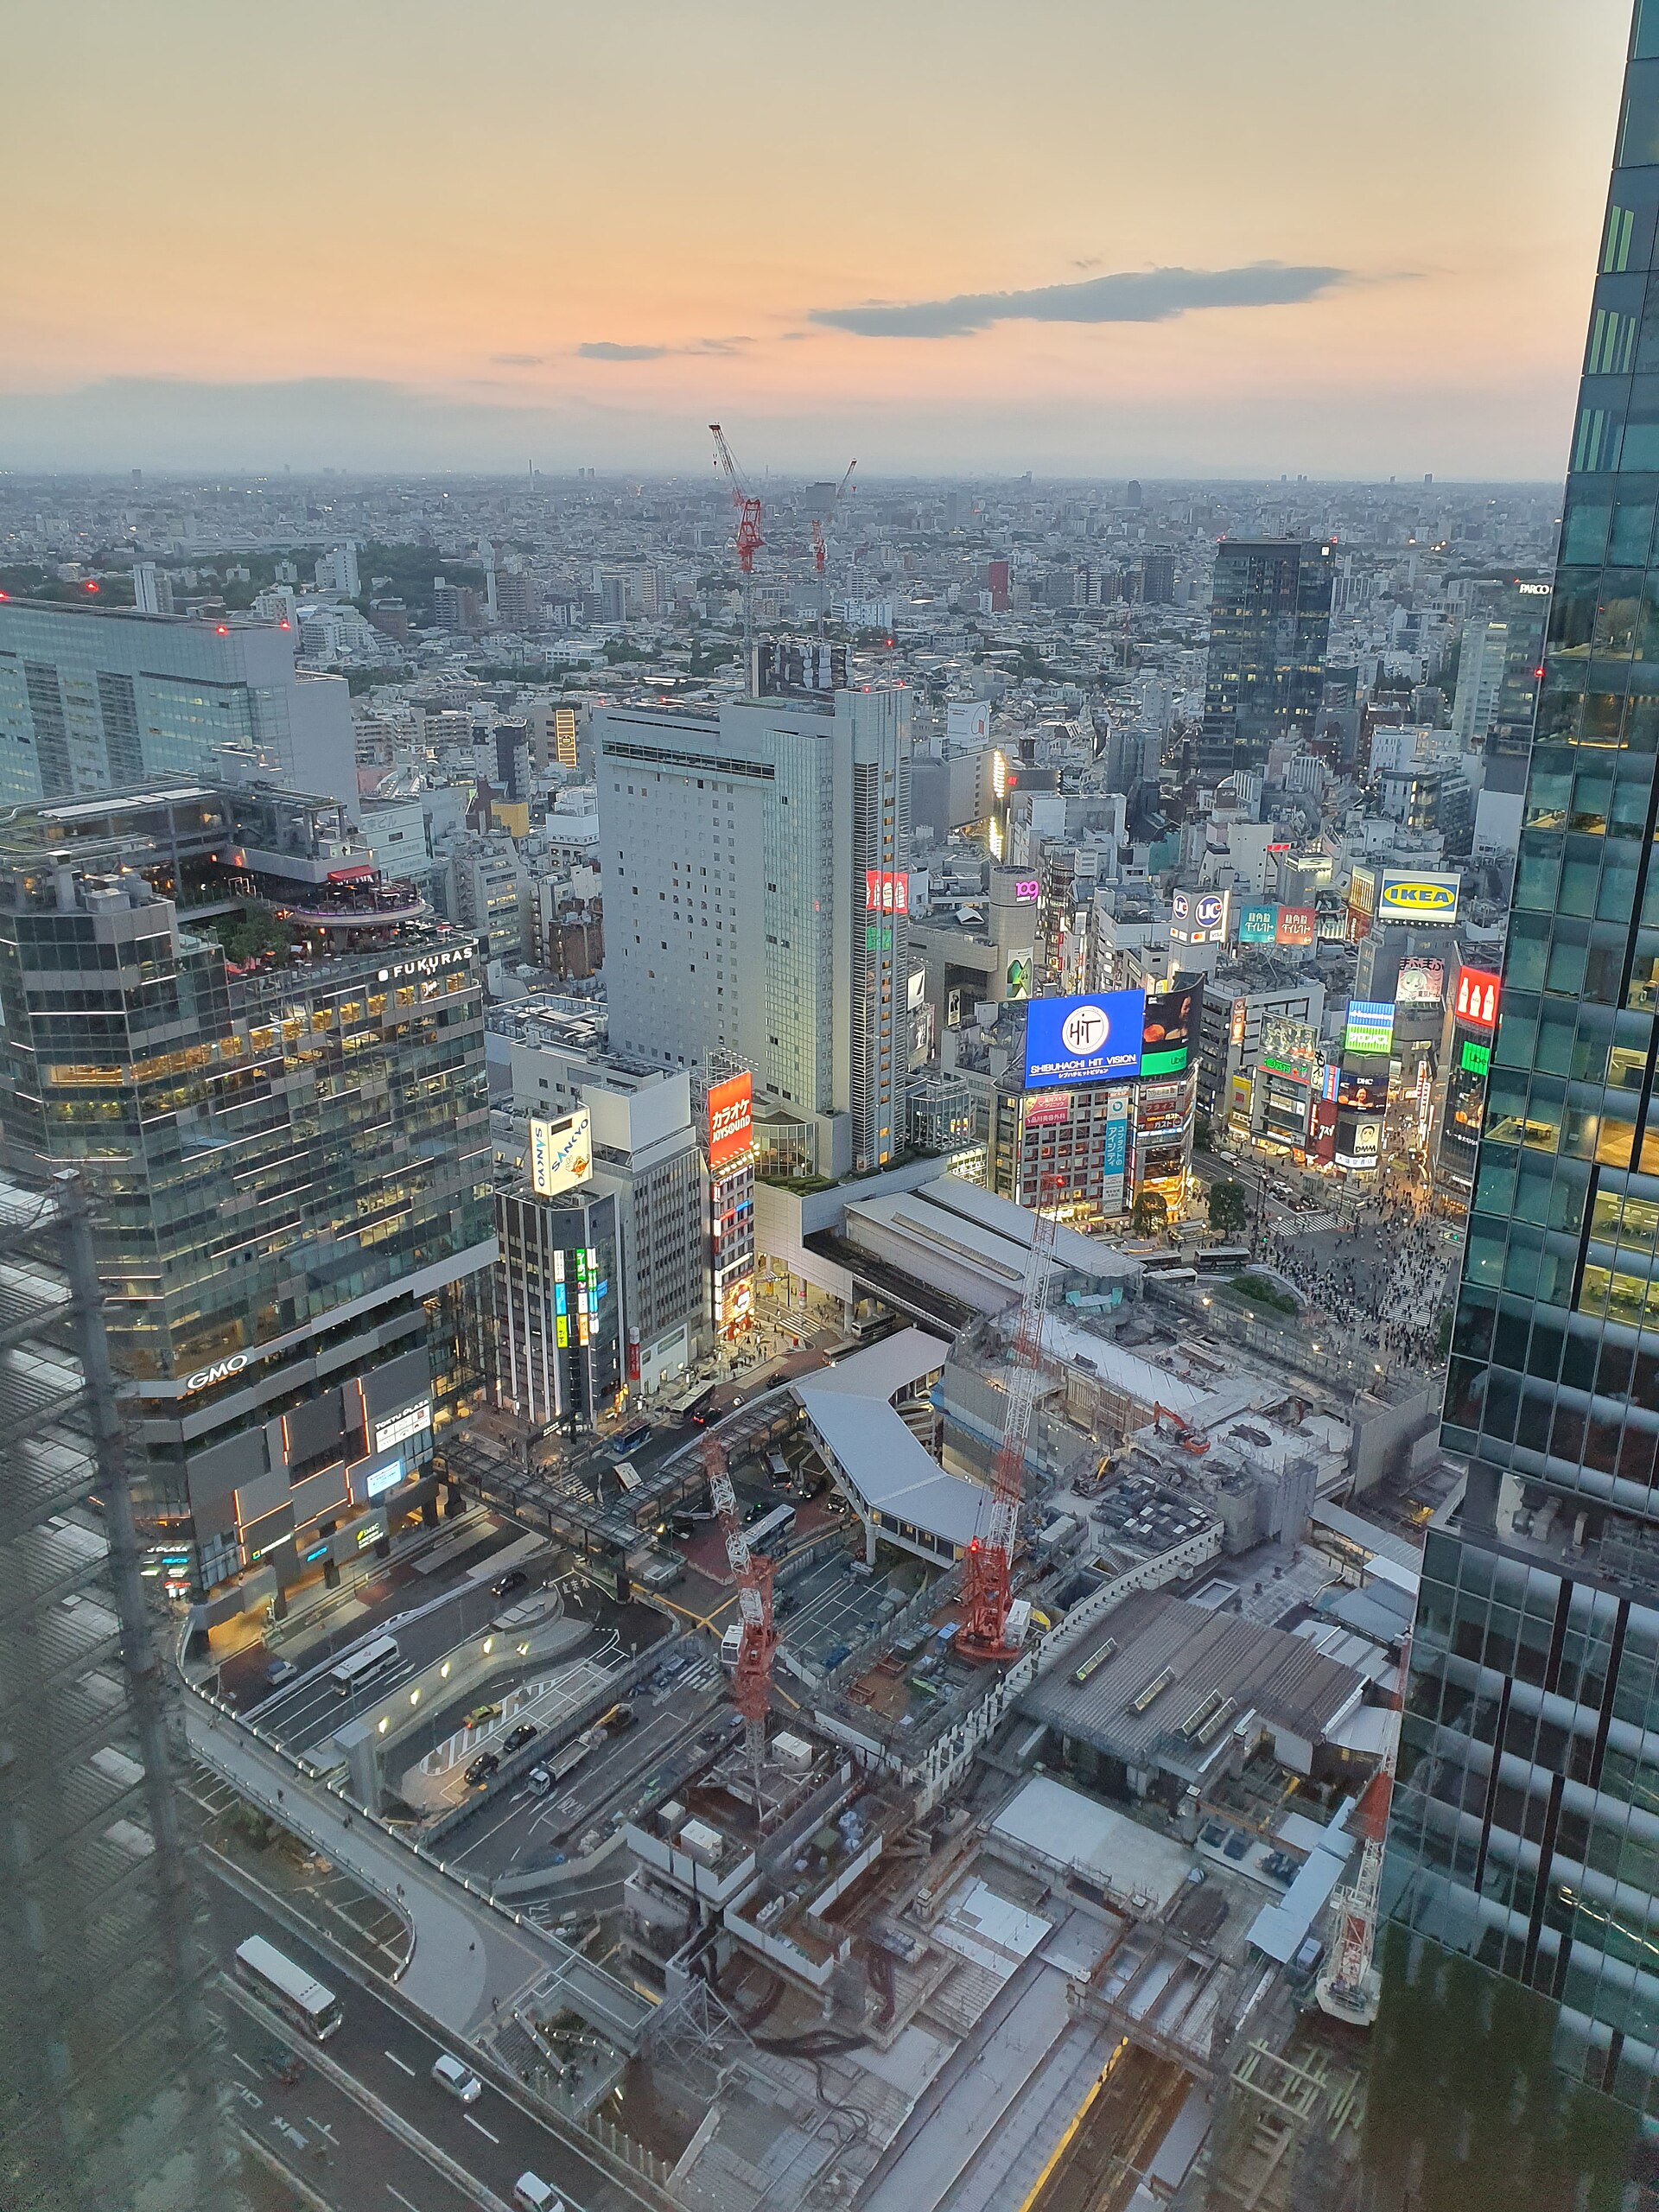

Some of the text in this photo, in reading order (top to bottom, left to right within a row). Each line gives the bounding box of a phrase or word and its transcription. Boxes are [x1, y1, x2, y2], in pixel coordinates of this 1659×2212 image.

[1519, 583, 1549, 594] PARCO
[1015, 880, 1039, 901] 109
[1389, 888, 1450, 903] IKEA
[1198, 901, 1223, 920] UC
[393, 947, 473, 978] FUKURAS
[1030, 1053, 1136, 1074] SHIBUHACHI HIT VISION
[1469, 1052, 1487, 1065] Ube
[712, 1099, 750, 1130] カラオケ
[712, 1115, 751, 1144] JOYSOUND
[535, 1127, 547, 1187] SANKYO
[551, 1118, 589, 1173] SANKYO
[1107, 1127, 1117, 1166] アイシティ
[1116, 1126, 1124, 1166] コンタクトの
[188, 1355, 248, 1389] GMO
[402, 1399, 429, 1416] PLAZA
[563, 1578, 590, 1594] 止まれ
